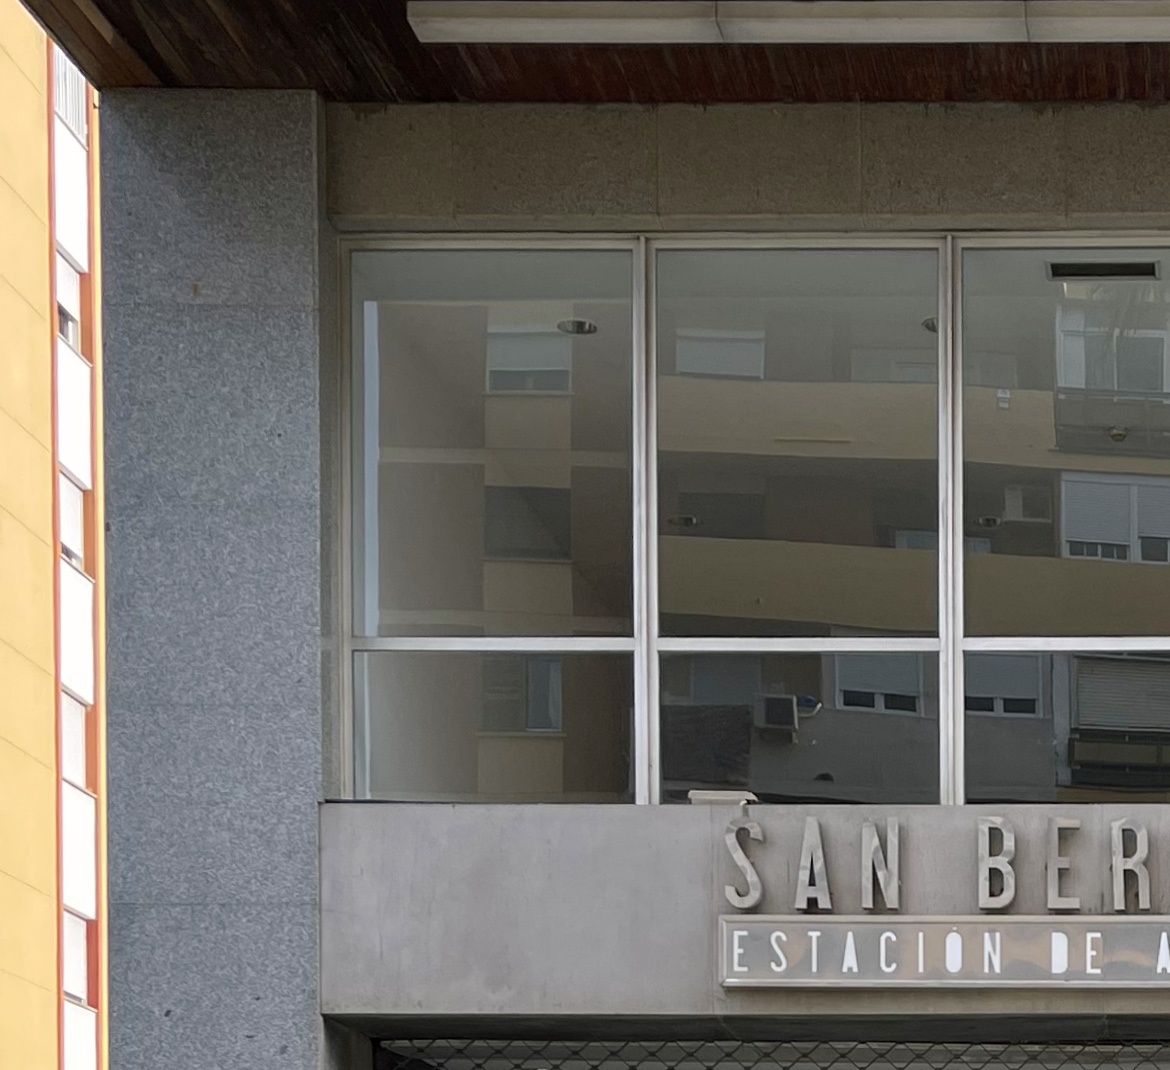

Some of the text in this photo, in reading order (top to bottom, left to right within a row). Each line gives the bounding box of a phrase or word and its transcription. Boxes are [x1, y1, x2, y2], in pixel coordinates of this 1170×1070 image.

[724, 816, 900, 911] SAN
[733, 926, 1001, 974] ESTACIÓN
[1051, 931, 1102, 974] DE
